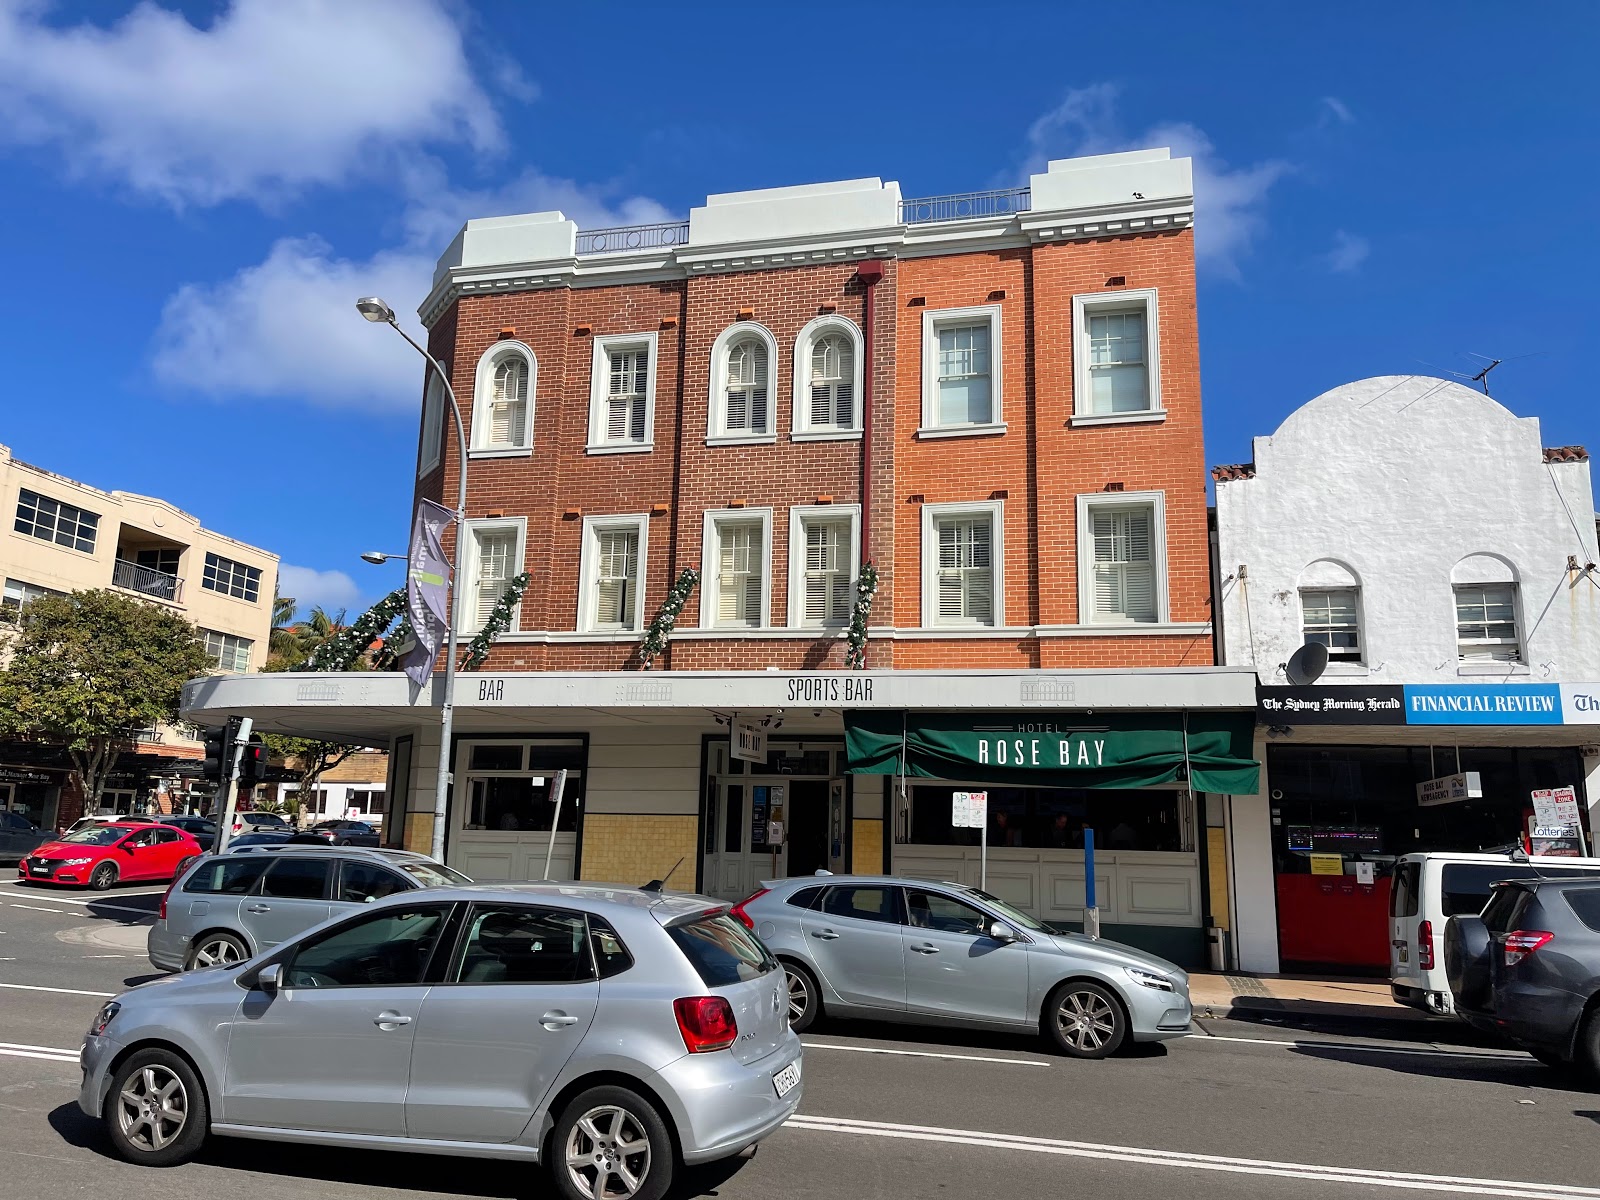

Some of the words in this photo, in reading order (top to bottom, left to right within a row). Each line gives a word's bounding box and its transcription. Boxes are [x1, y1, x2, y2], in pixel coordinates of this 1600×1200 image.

[479, 680, 504, 701] BAR
[788, 679, 838, 701] SPORTS
[845, 679, 873, 701] BAR
[1262, 698, 1283, 711] The
[1284, 698, 1321, 712] Sydney
[1322, 698, 1366, 712] Morning
[1366, 698, 1401, 712] Herald
[1412, 695, 1494, 712] FINANCIAL
[1495, 695, 1555, 712] REVIEW
[1573, 694, 1600, 712] Th
[1018, 723, 1062, 734] HOTEL
[978, 739, 1040, 765] ROSE
[1059, 739, 1105, 766] BAY
[1423, 782, 1435, 793] ROSE
[1533, 827, 1575, 837] Lotteries
